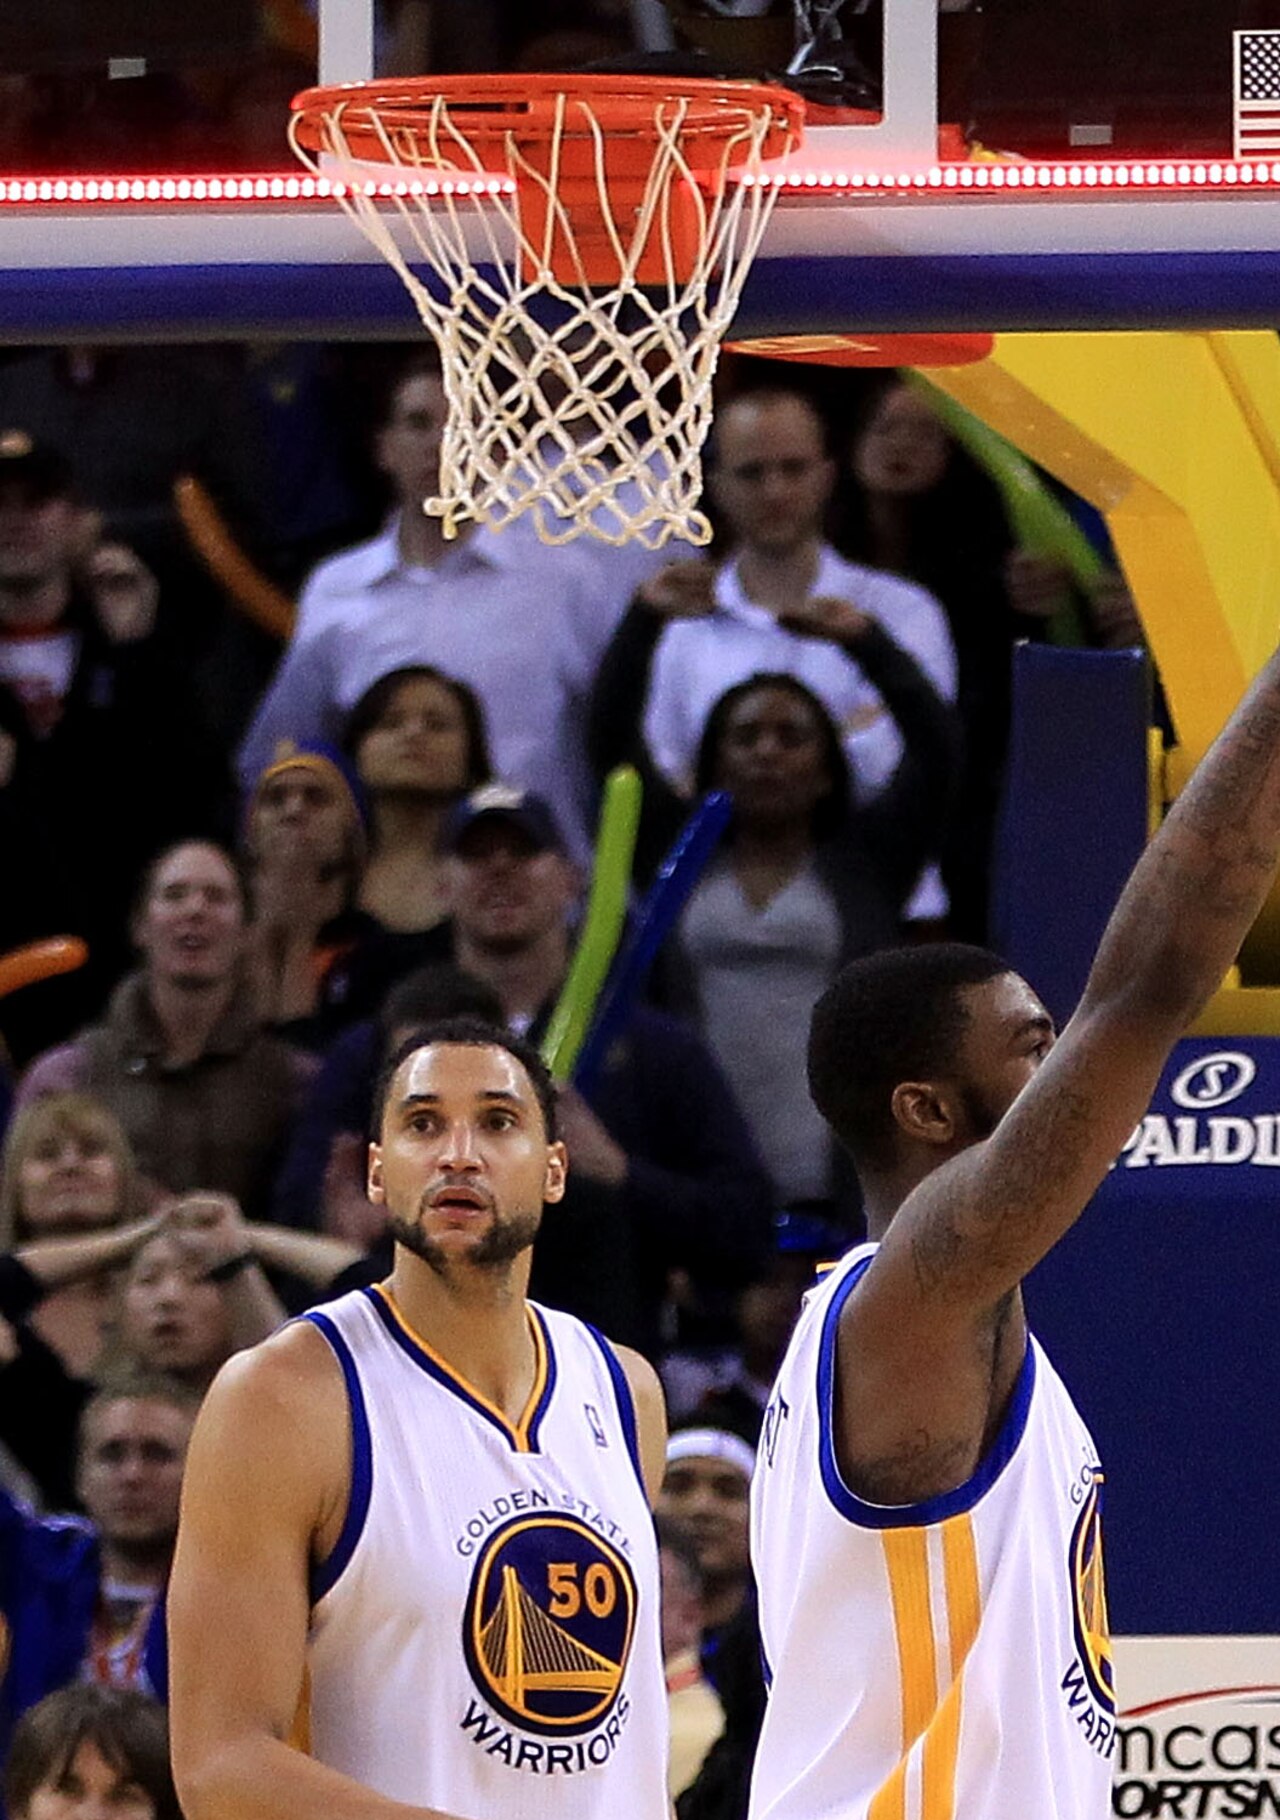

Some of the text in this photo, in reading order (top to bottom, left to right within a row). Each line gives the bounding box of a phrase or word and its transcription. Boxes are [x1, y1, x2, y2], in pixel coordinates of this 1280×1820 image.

[456, 1488, 551, 1558] GOLDEN
[547, 1561, 617, 1619] 50
[459, 1695, 631, 1775] WARRIORS
